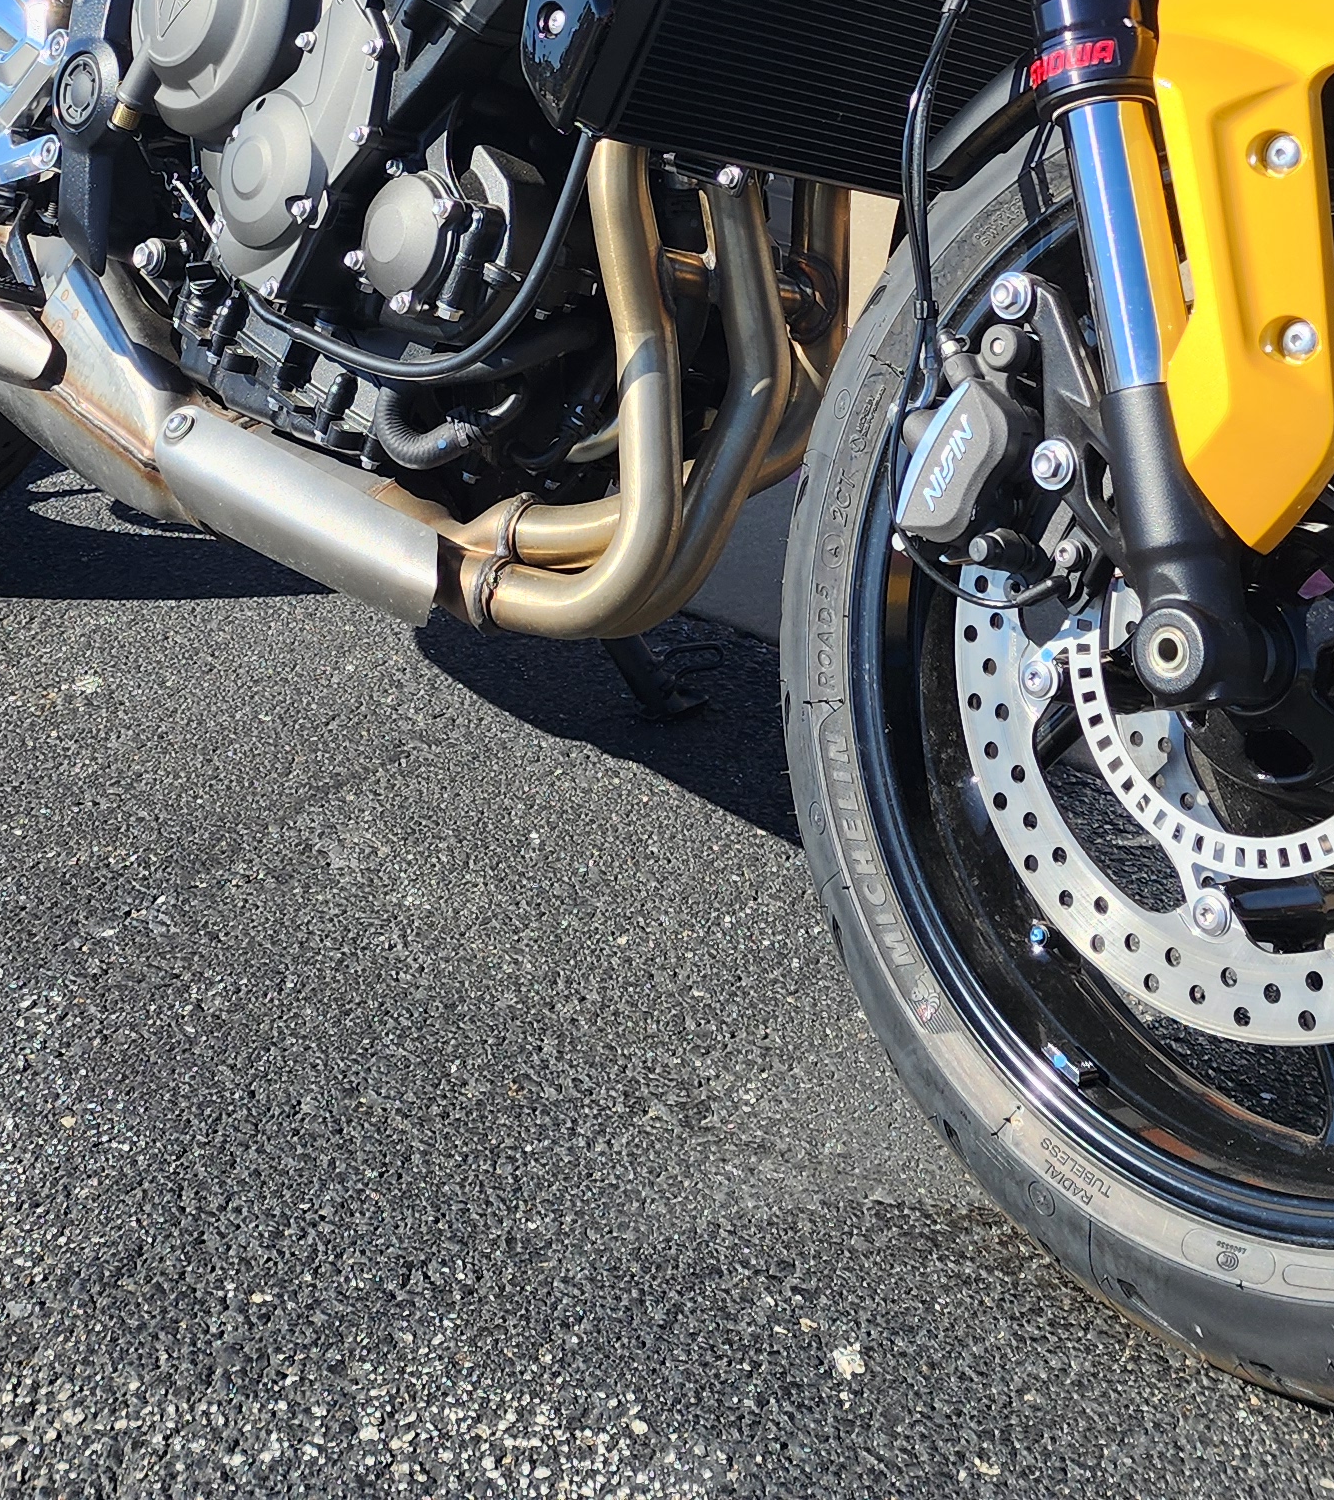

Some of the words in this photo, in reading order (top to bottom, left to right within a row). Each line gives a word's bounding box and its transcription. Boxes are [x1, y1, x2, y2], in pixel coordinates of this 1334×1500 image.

[1029, 39, 1115, 90] SHOWA
[922, 414, 974, 512] NISSIN
[831, 467, 857, 528] 2CT
[815, 582, 830, 600] 5
[817, 607, 834, 692] ROAD
[825, 734, 917, 970] MICHELIN
[1039, 1137, 1112, 1199] TUBELESS
[1044, 1159, 1093, 1206] RADIAL
